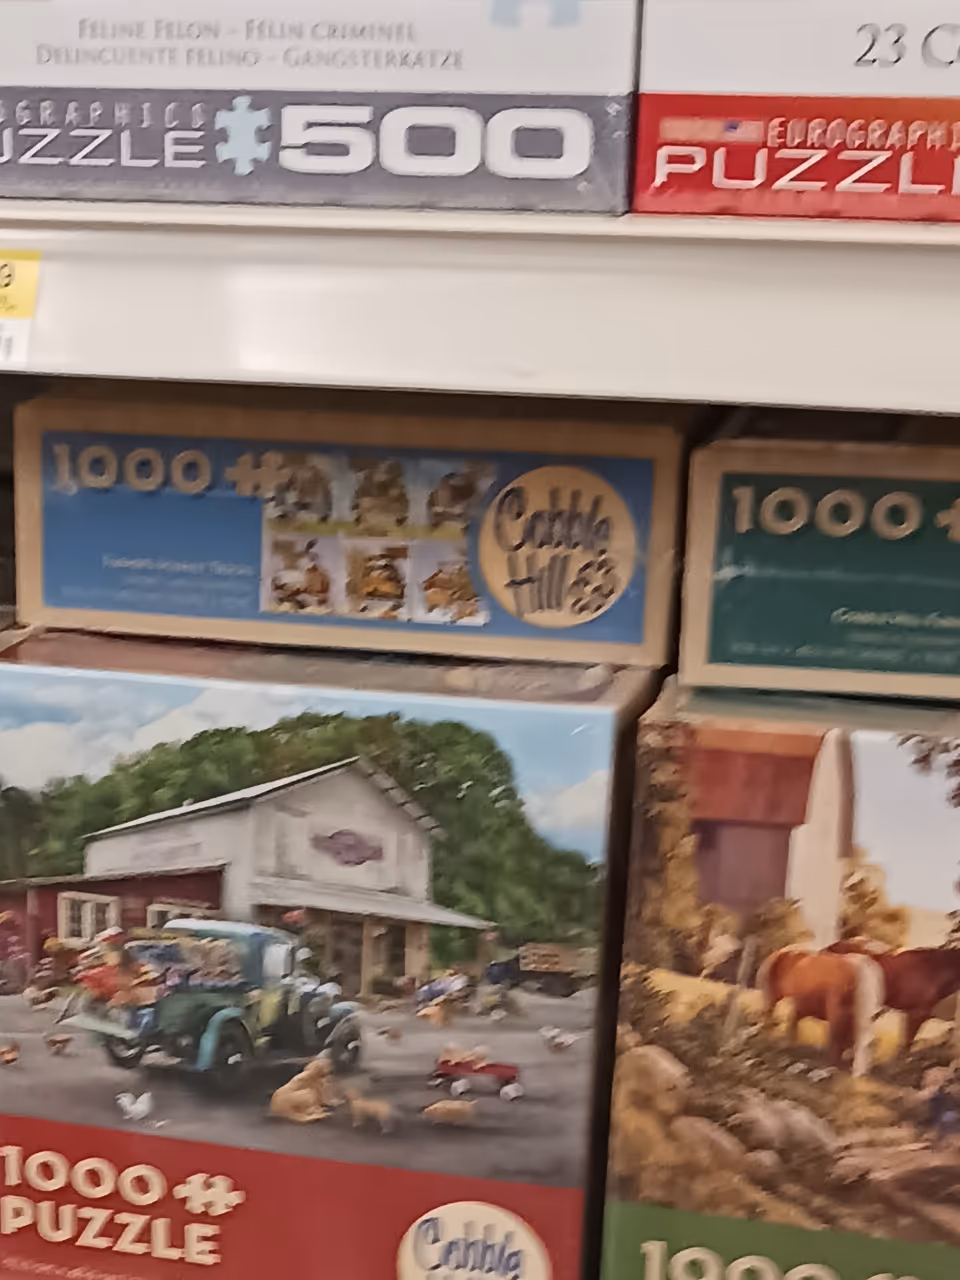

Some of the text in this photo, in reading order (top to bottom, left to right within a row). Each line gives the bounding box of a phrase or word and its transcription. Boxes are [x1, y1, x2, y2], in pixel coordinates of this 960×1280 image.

[853, 21, 908, 68] 23
[278, 104, 594, 180] 500
[653, 145, 960, 195] PUZZL
[51, 443, 212, 495] 1000
[731, 485, 924, 541] 1000
[412, 1216, 525, 1278] Cobble
